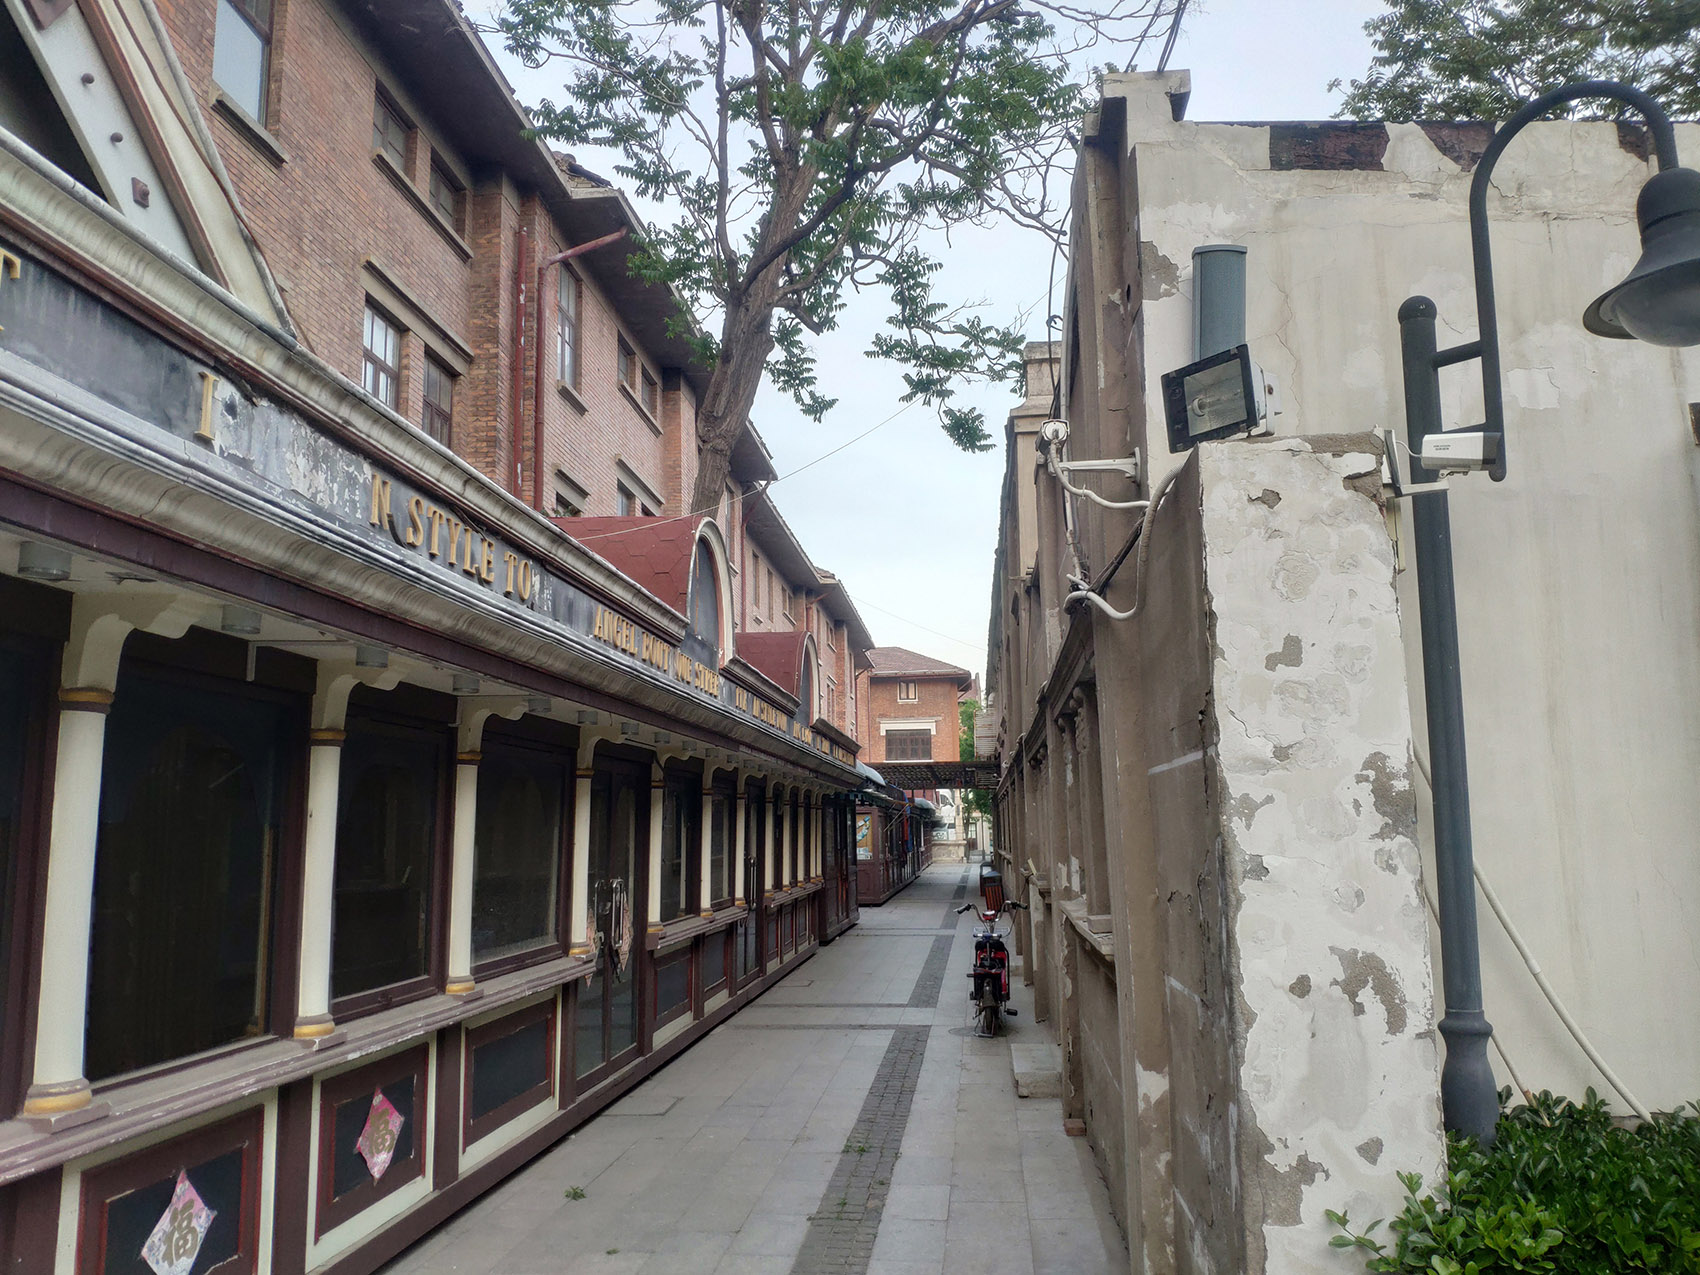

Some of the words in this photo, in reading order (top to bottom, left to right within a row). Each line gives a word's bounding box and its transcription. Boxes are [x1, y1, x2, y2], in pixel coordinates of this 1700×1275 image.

[406, 495, 495, 584] STYLE
[503, 551, 532, 601] TO
[593, 602, 638, 657] ANGEL
[368, 1107, 395, 1155] 福
[161, 1198, 199, 1268] 福
